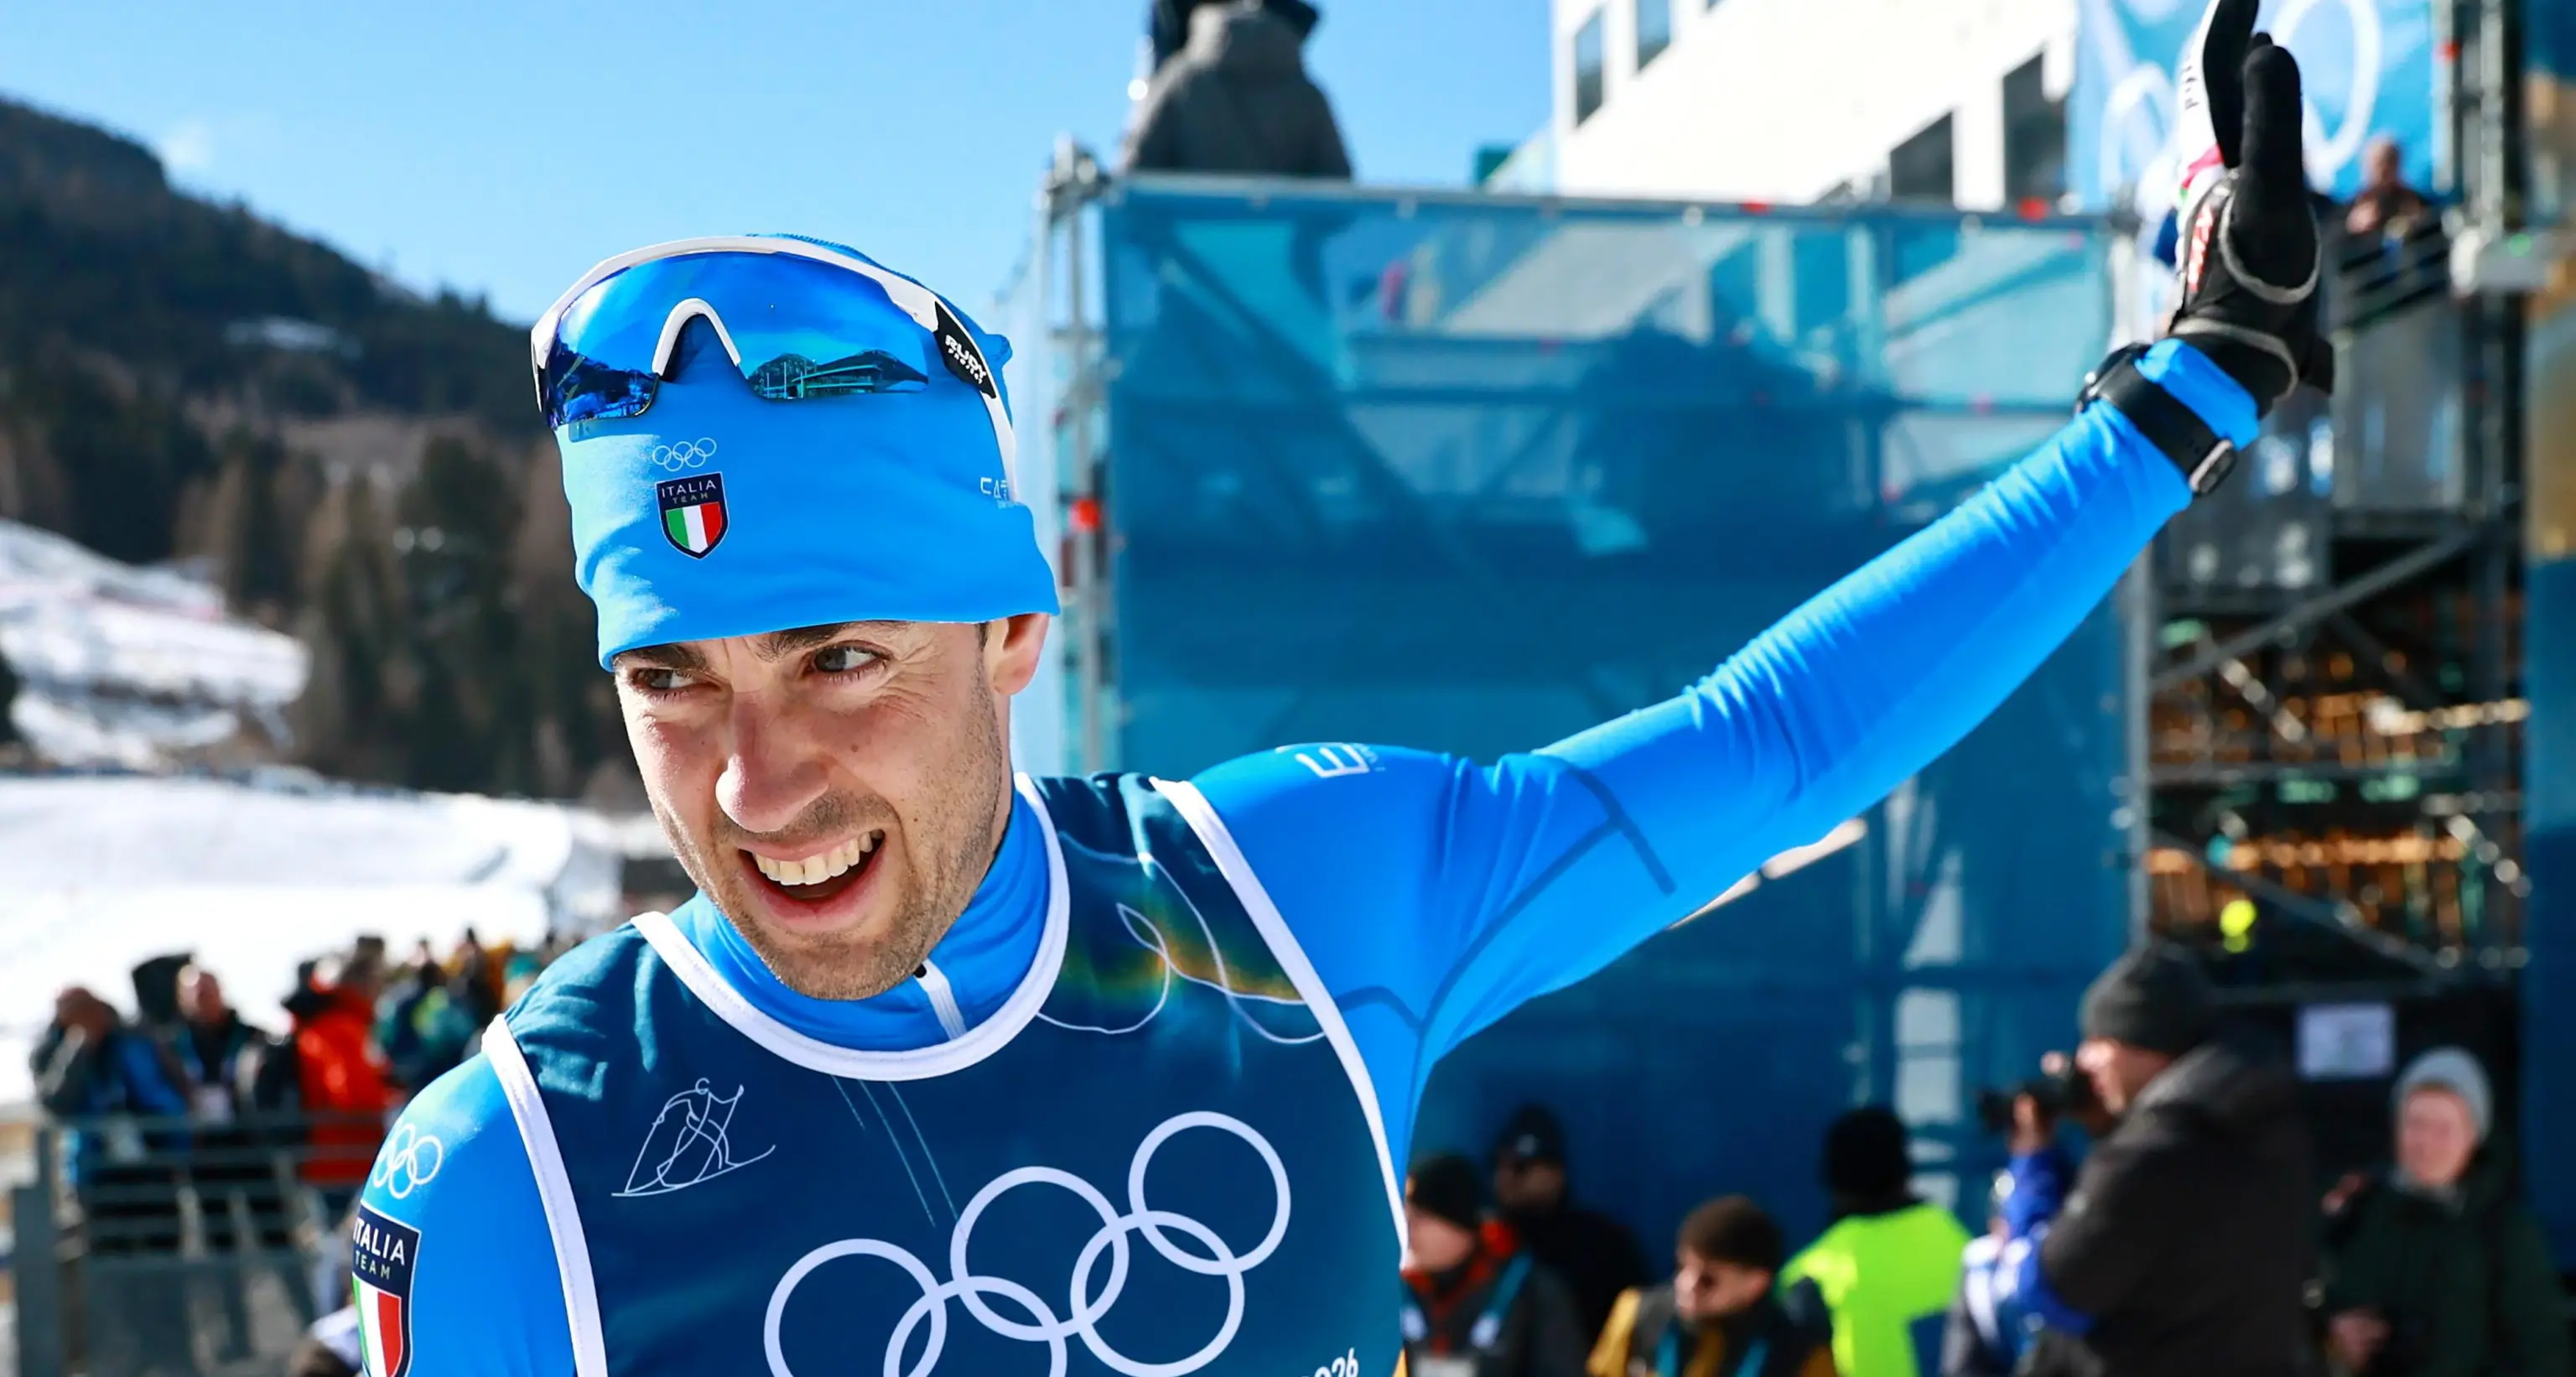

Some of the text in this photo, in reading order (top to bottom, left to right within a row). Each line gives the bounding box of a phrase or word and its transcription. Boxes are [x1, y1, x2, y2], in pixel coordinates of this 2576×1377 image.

[945, 335, 987, 379] RUDY
[661, 480, 717, 498] ITALIA
[673, 492, 709, 504] TEAM
[353, 1217, 405, 1265] ITALIA
[356, 1250, 391, 1280] TEAM
